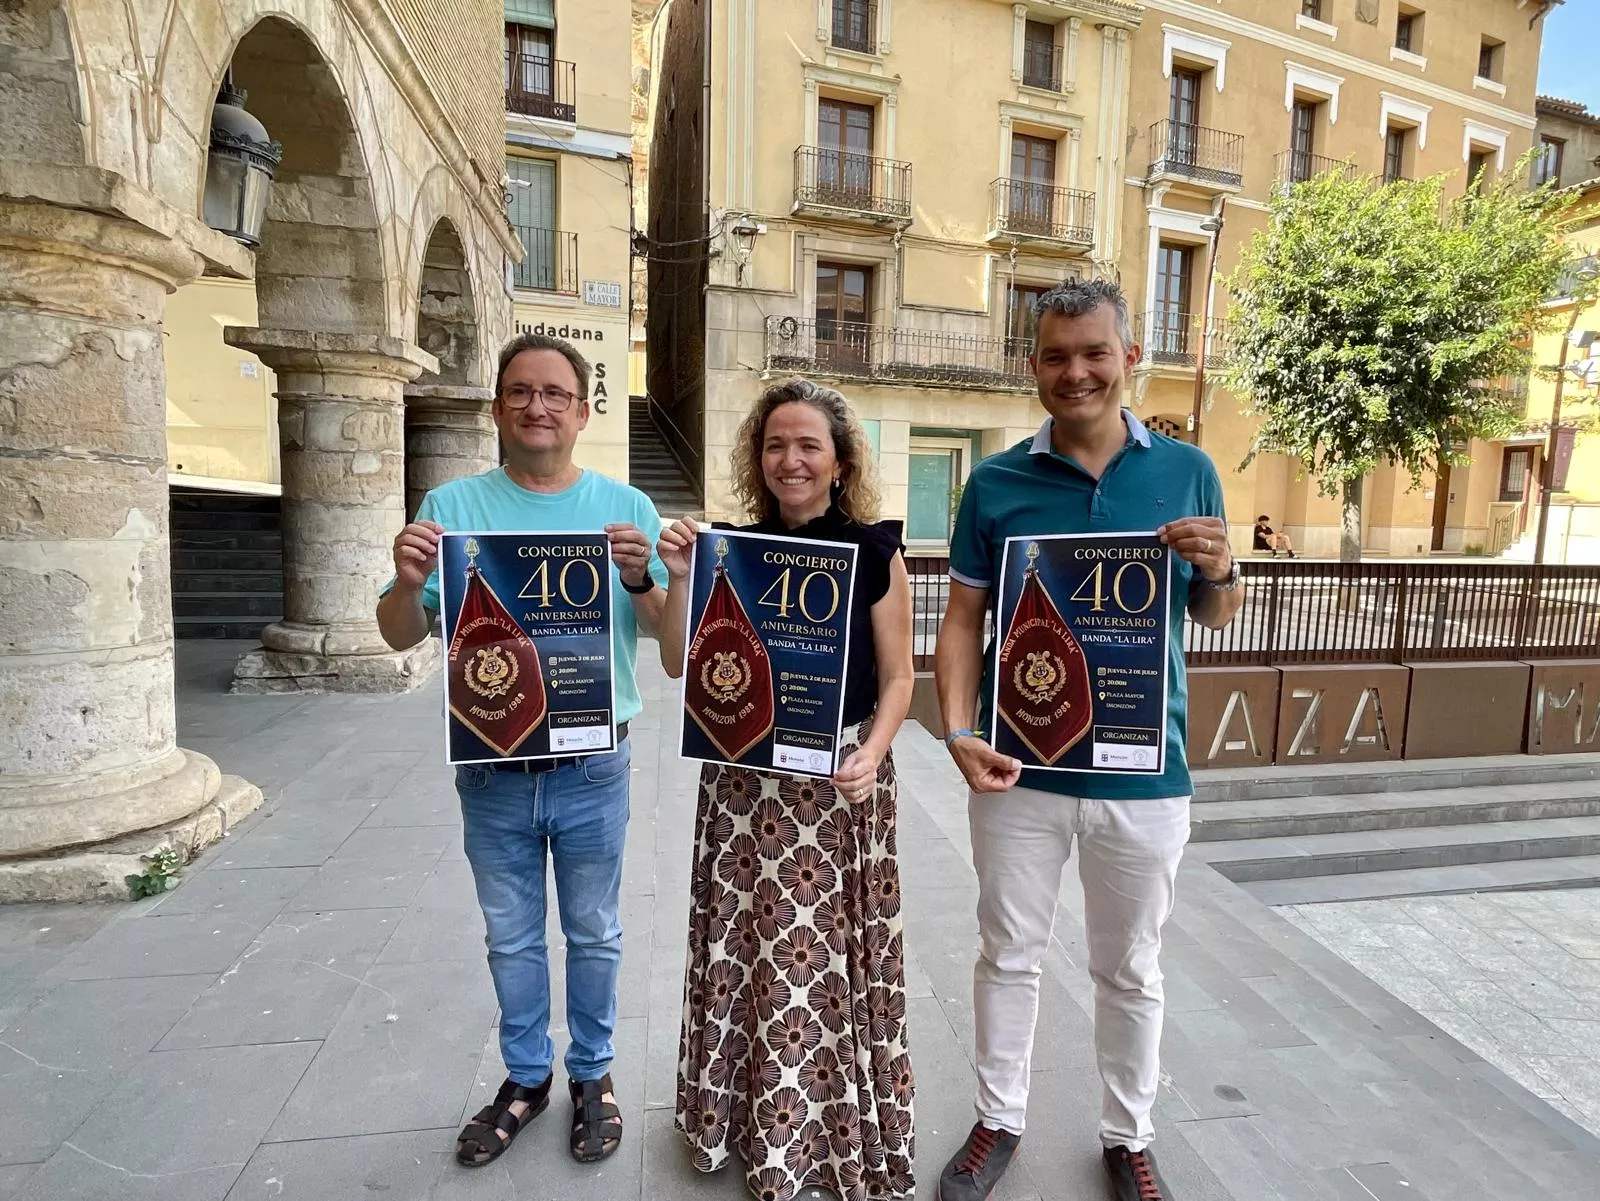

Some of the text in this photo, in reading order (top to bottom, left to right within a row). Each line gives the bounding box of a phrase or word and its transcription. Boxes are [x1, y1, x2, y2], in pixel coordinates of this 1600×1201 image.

[597, 284, 617, 294] CALLE
[589, 293, 617, 304] MAYOR
[515, 320, 604, 341] iudadana
[517, 545, 604, 558] CONCIERTO
[1074, 547, 1163, 560] CONCIERTO
[763, 551, 848, 572] CONCIERTO
[517, 558, 601, 608] 40
[1069, 561, 1157, 614] 40
[757, 567, 840, 624] 40
[523, 610, 602, 621] ANIVERSARIO
[1074, 616, 1156, 628] ANIVERSARIO
[532, 628, 561, 636] BANDA
[580, 626, 602, 634] LIRA"
[760, 620, 838, 638] ANIVERSARIO
[449, 636, 464, 661] BANDA
[462, 616, 499, 637] MUNICIPAL
[689, 636, 705, 660] BANDA
[702, 617, 738, 637] MUNICIPAL
[767, 638, 837, 654] BANDA "LA LIRA"
[1000, 638, 1016, 662] BANDA
[1013, 617, 1050, 639] MUNICIPAL
[1081, 634, 1156, 645] BANDA "LA LIRA"
[469, 704, 507, 721] MONZON
[702, 706, 736, 725] MONZON
[1015, 708, 1052, 726] MONZON
[1207, 687, 1391, 761] AZA
